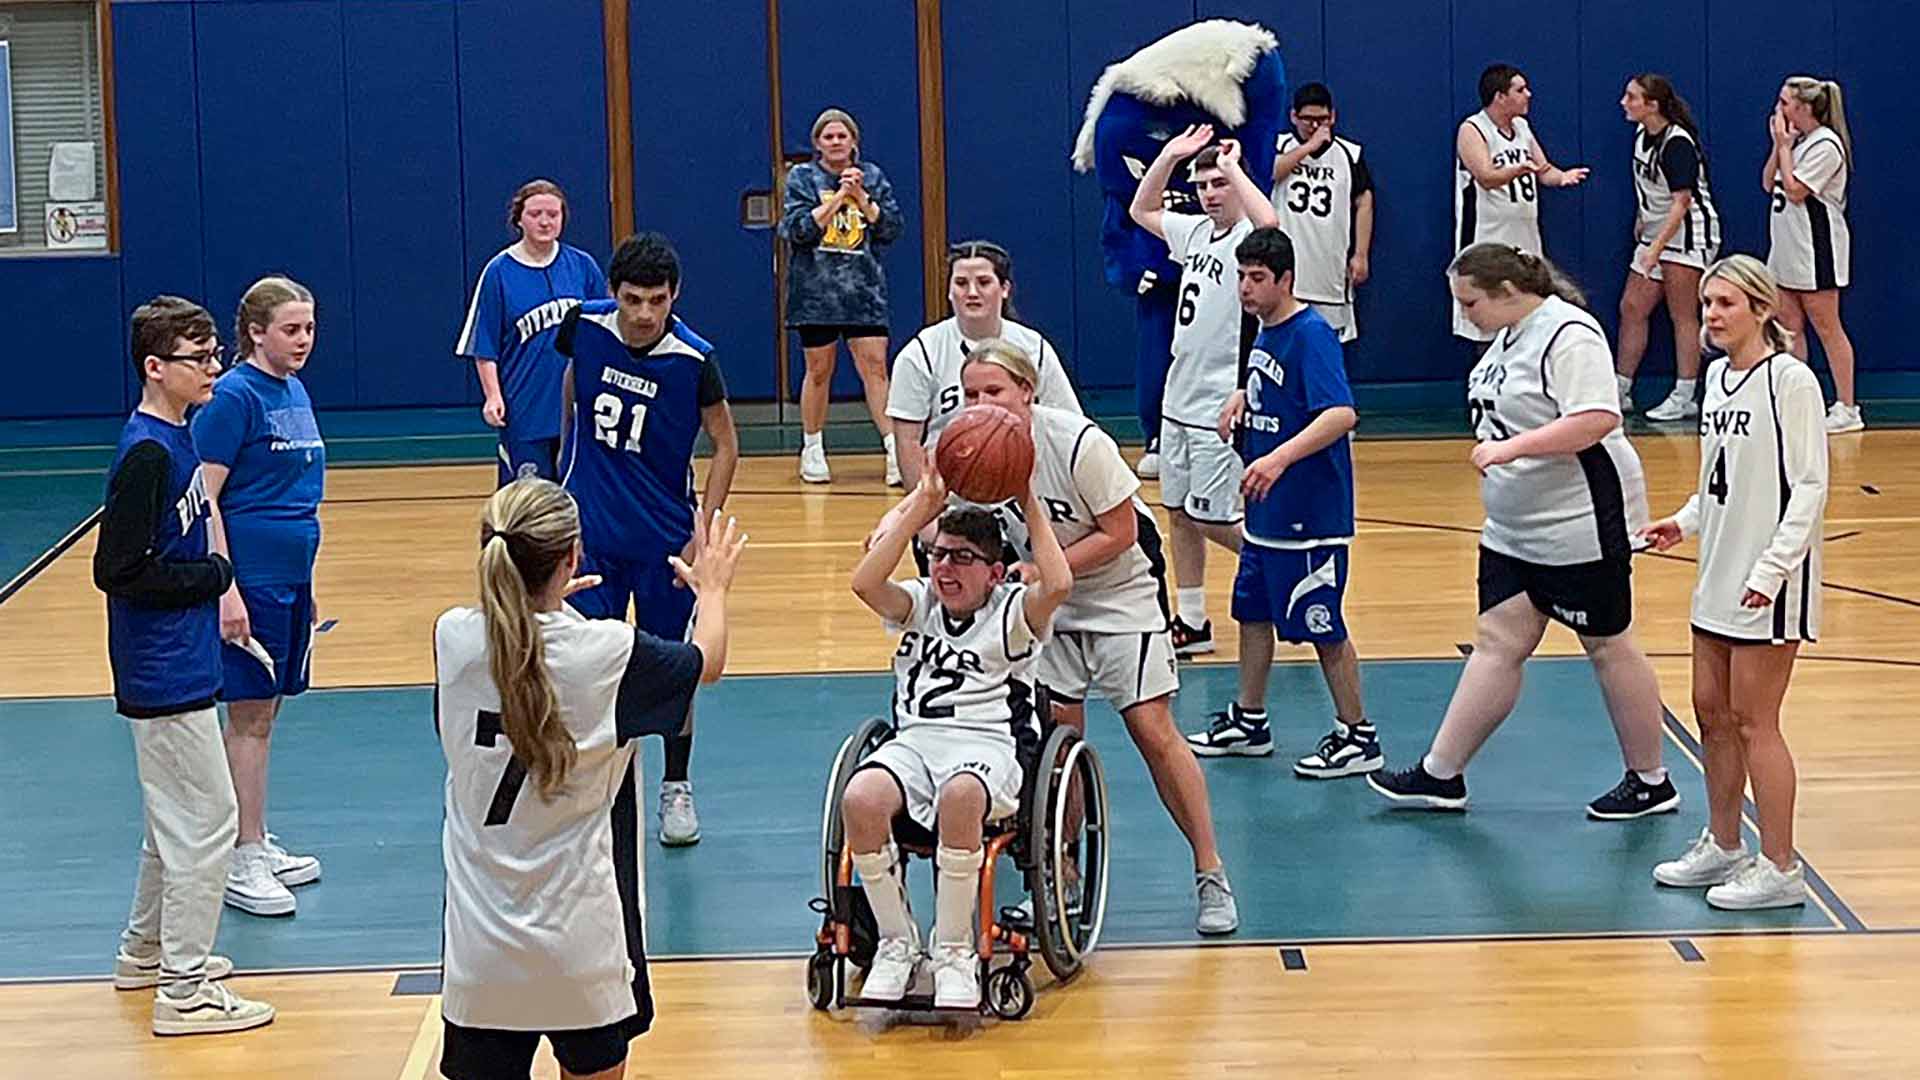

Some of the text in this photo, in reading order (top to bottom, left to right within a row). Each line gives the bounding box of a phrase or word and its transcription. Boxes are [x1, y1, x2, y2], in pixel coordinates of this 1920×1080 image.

[1290, 161, 1335, 180] SWR
[1508, 172, 1535, 203] 18
[1287, 181, 1332, 217] 33
[1179, 282, 1200, 327] 6
[594, 392, 647, 453] 21
[1700, 410, 1751, 437] SWR
[1708, 446, 1728, 506] 4
[896, 631, 984, 674] SWR
[904, 660, 967, 719] 12
[474, 709, 529, 826] 7
